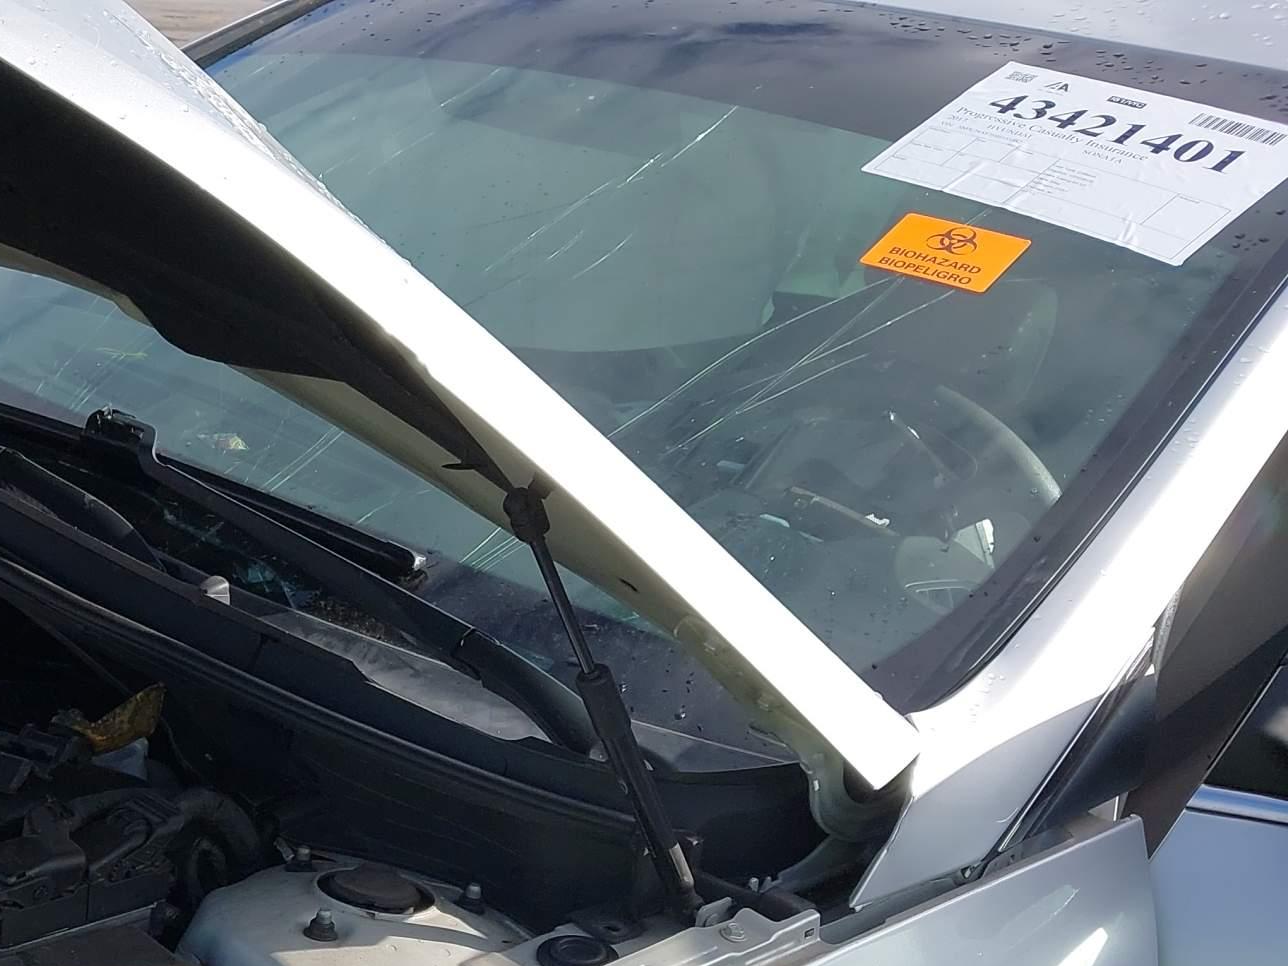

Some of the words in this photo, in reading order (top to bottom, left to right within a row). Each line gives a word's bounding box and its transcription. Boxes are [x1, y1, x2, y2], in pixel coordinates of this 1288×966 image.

[956, 106, 1027, 129] Progressive
[1029, 123, 1080, 143] Casualty
[1085, 139, 1149, 161] Insurance
[989, 94, 1248, 175] 43421401
[1083, 149, 1124, 164] SONATA
[878, 257, 972, 286] BIOPELIGRO
[888, 245, 982, 275] BIOHAZARD
